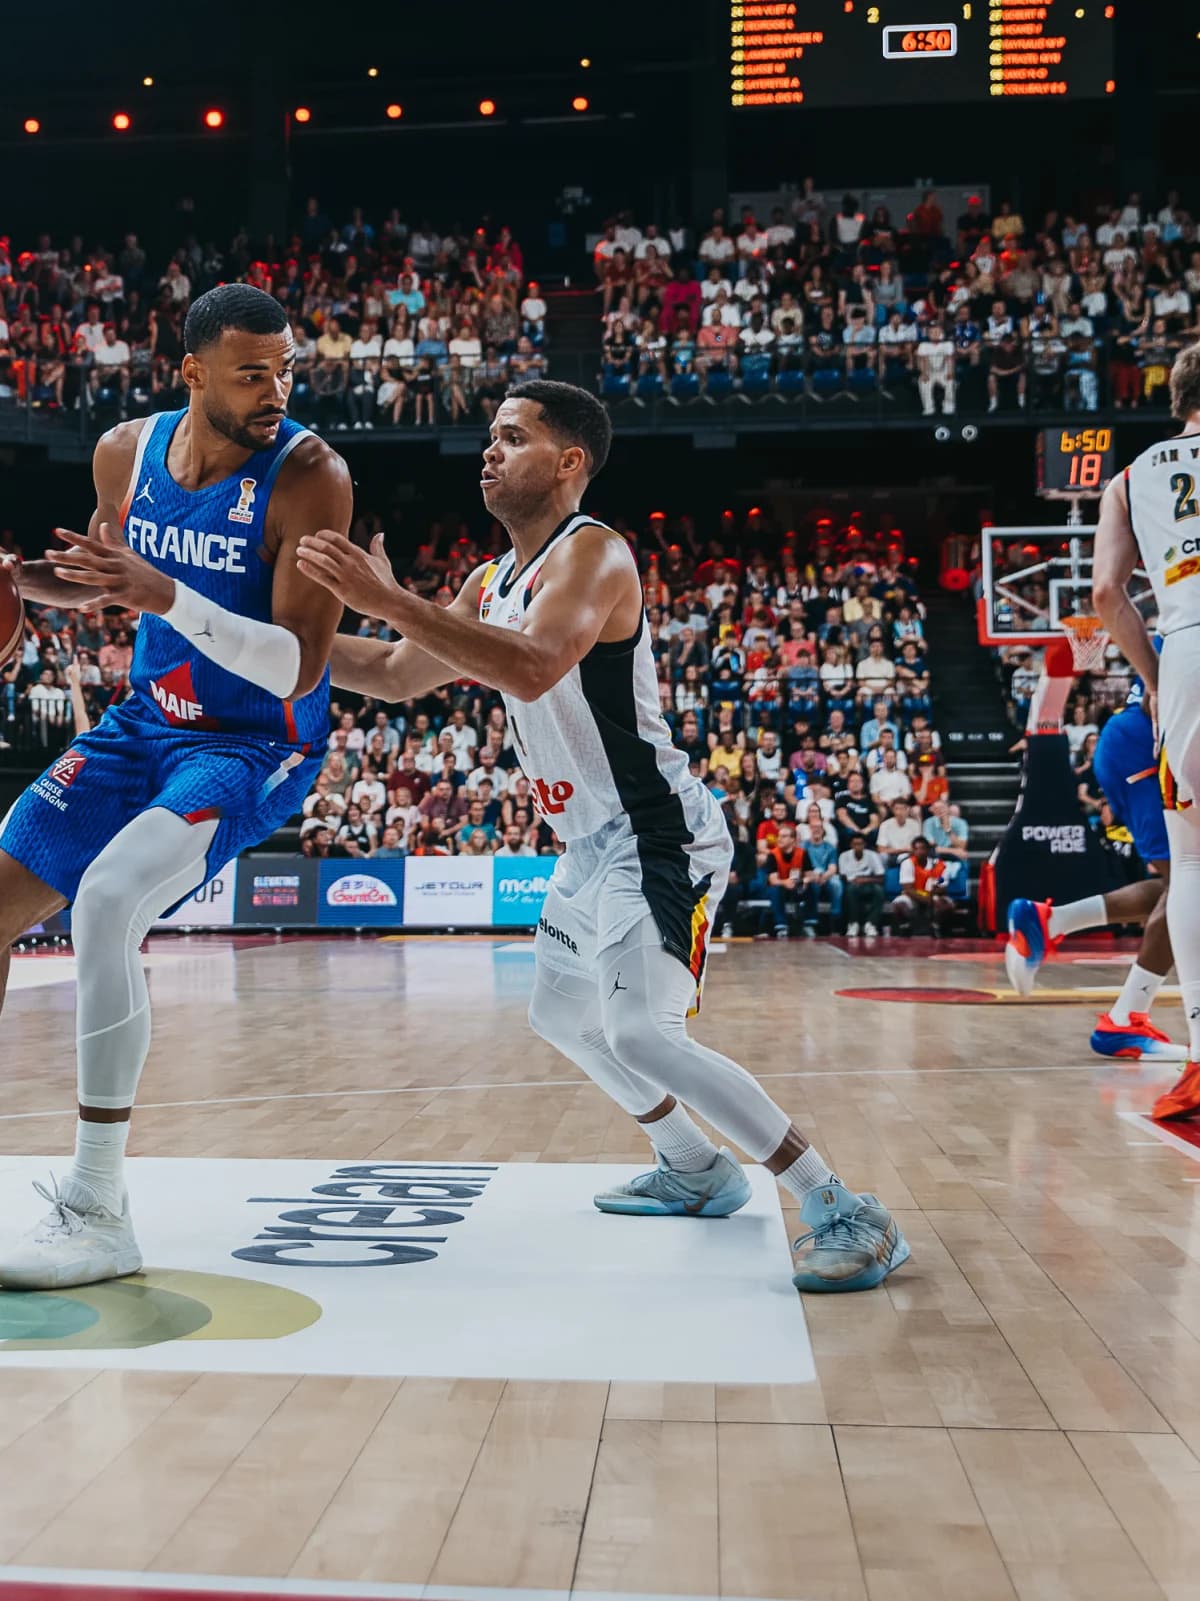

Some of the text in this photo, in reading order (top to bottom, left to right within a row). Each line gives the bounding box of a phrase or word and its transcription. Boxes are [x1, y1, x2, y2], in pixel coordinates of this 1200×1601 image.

[867, 7, 880, 24] 2
[902, 30, 952, 53] 6:50
[1060, 429, 1112, 453] 6:50
[1069, 453, 1102, 487] 18
[128, 515, 248, 574] FRANCE
[150, 680, 203, 721] MAIF
[40, 778, 64, 798] CAISSE
[1022, 825, 1086, 841] POWER
[1050, 839, 1087, 853] ADE
[194, 879, 224, 903] UP
[416, 881, 484, 891] JETOUR
[499, 876, 550, 894] molt
[538, 917, 581, 957] eloitte.
[231, 1164, 500, 1268] crelan
